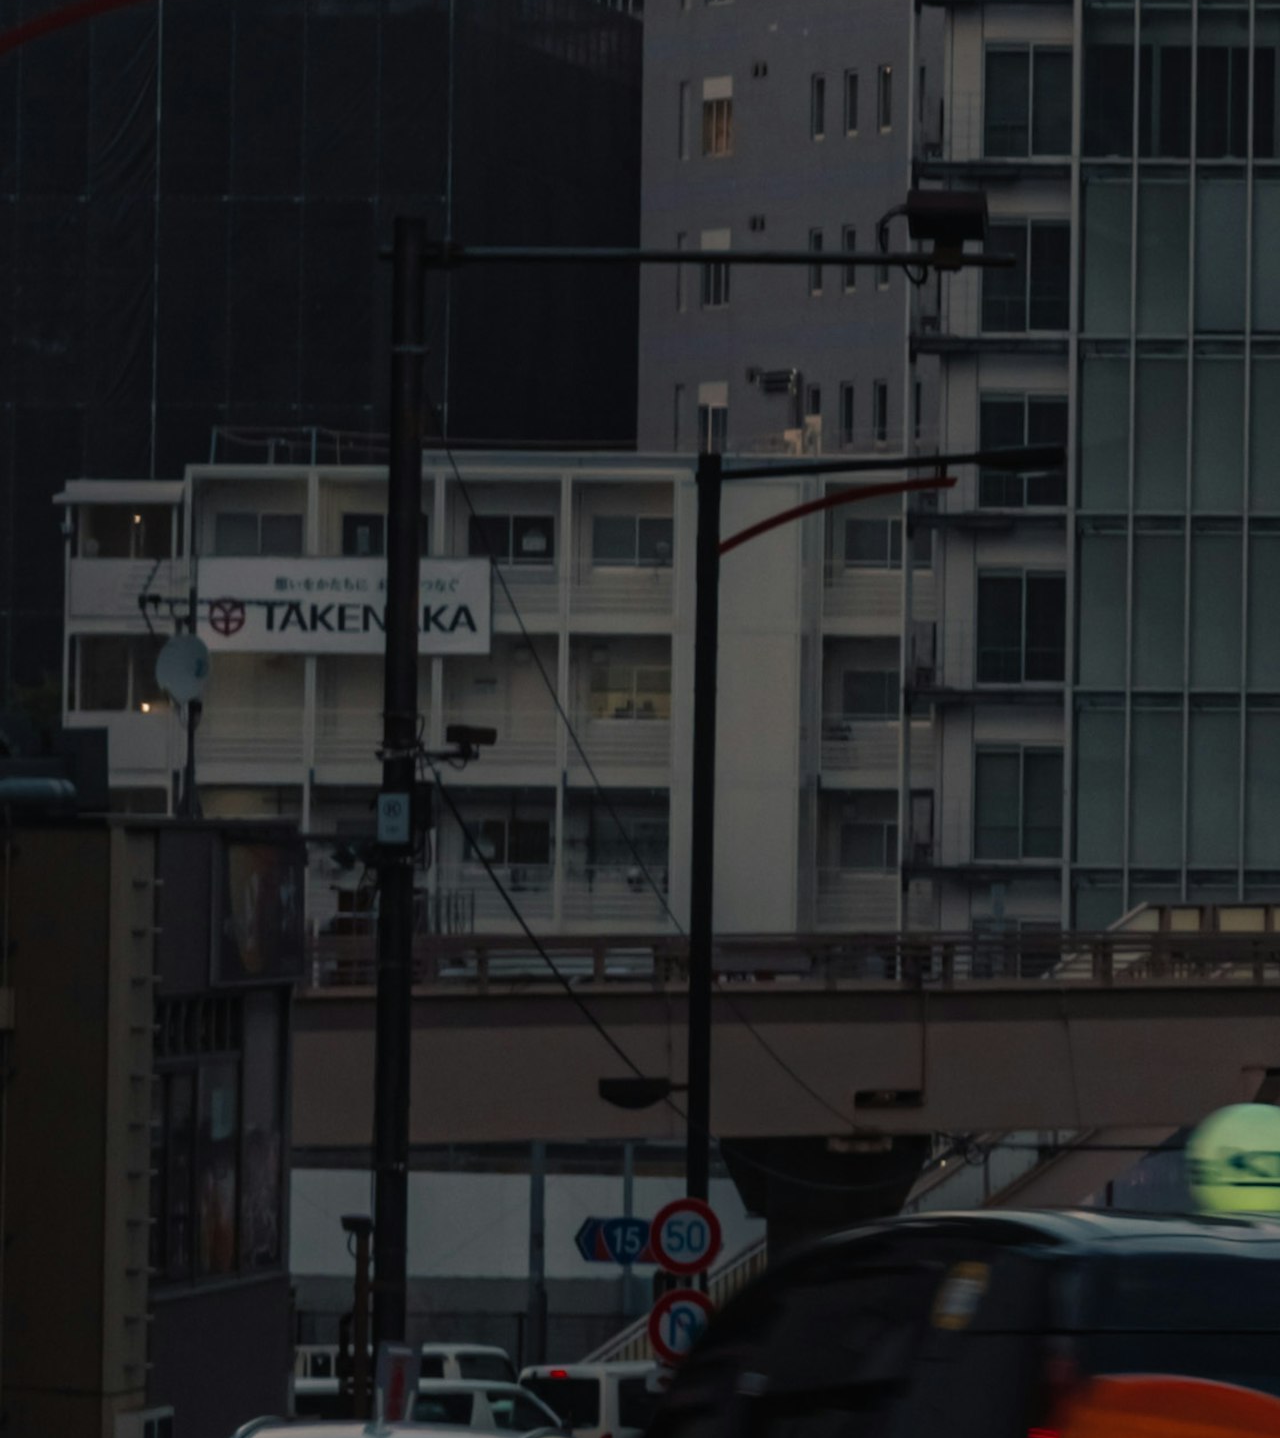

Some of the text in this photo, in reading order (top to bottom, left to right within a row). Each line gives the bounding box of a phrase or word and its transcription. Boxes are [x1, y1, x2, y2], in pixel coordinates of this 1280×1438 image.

[262, 603, 477, 632] TAKENKA
[613, 1225, 641, 1256] 15
[667, 1221, 705, 1253] 50
